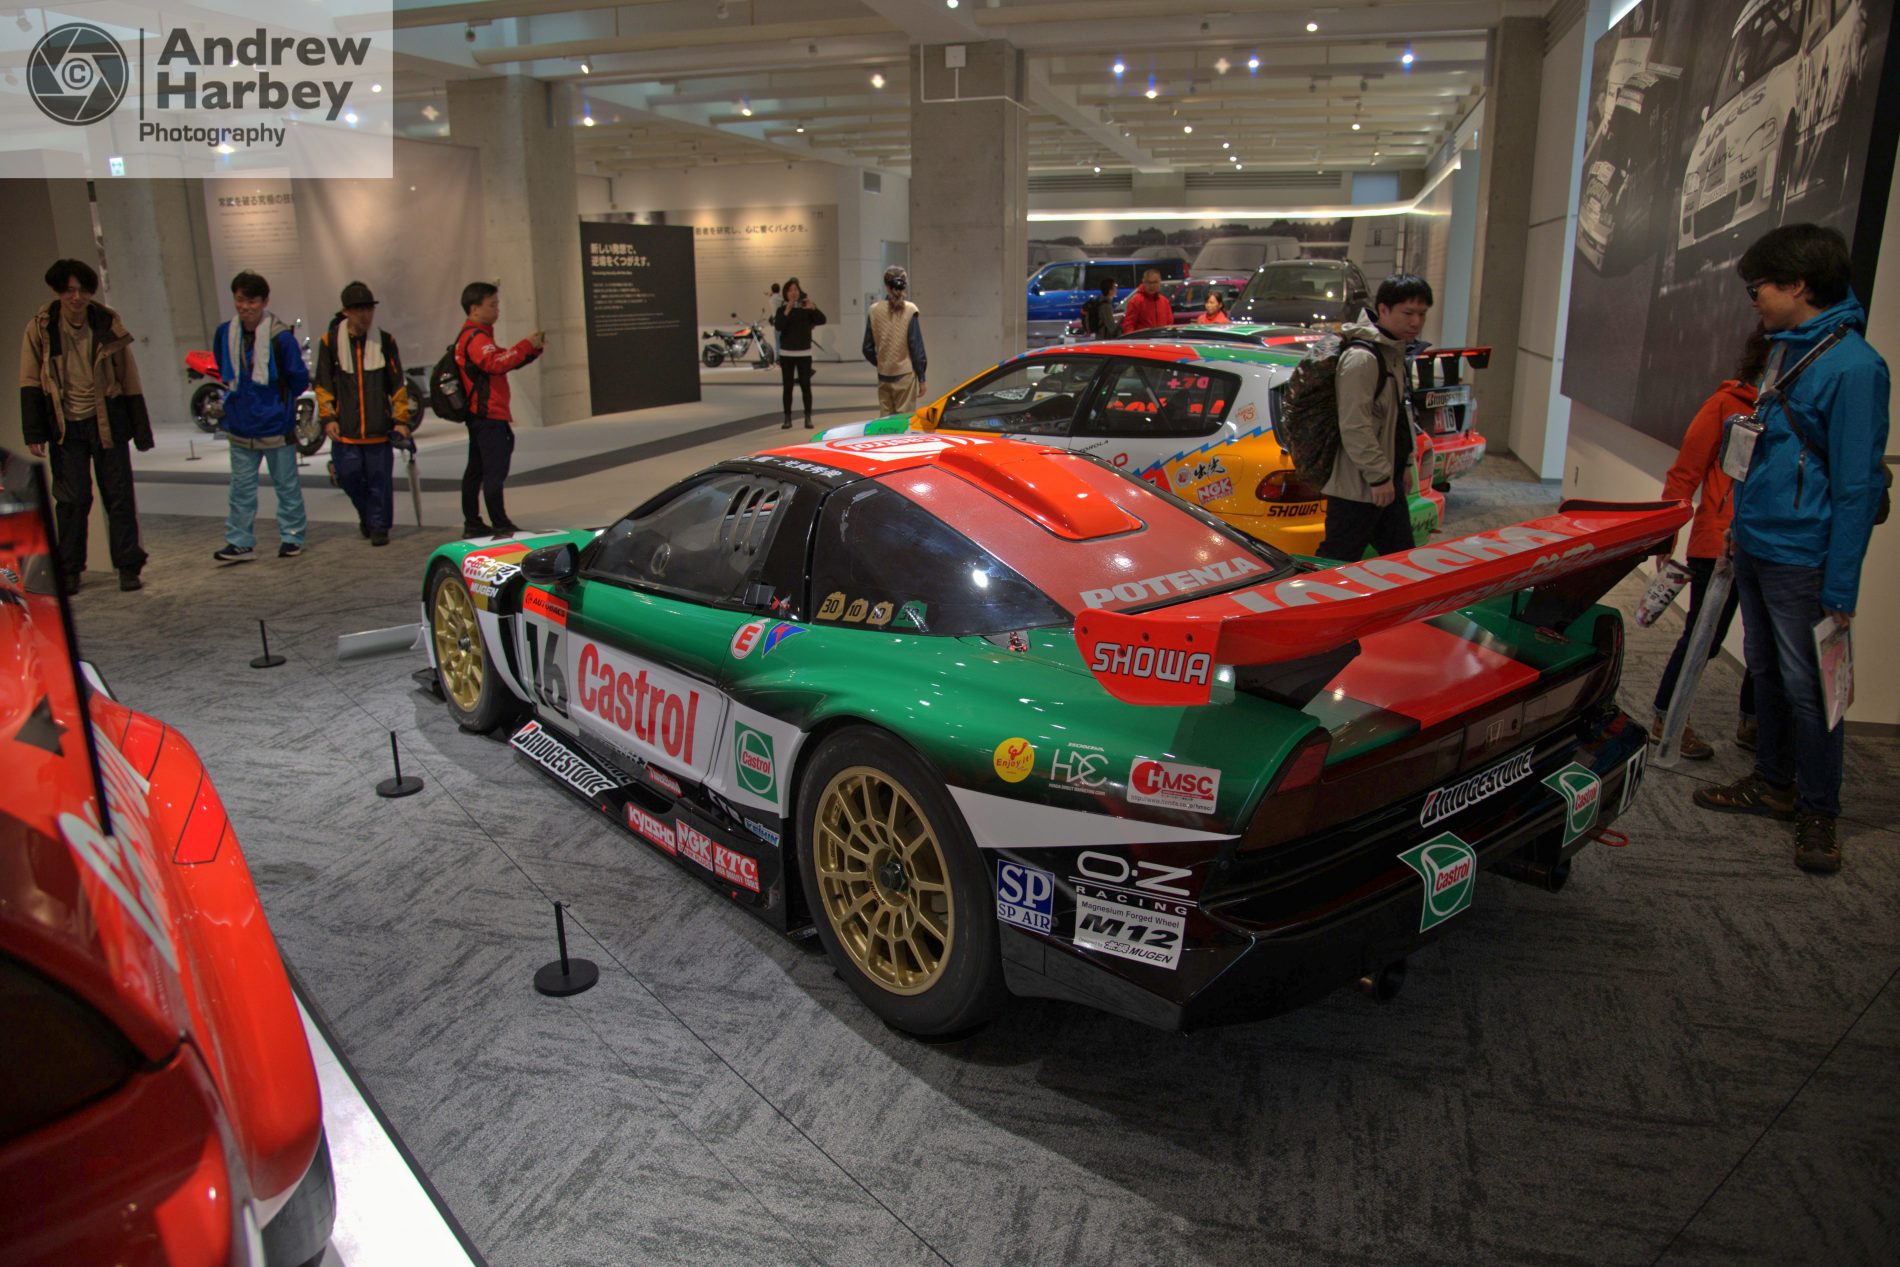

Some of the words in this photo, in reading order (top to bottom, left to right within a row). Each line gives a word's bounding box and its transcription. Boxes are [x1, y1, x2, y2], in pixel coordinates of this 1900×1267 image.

[1198, 479, 1233, 502] NGK
[1267, 503, 1319, 517] SHOWA
[469, 581, 500, 599] MUGEN
[1080, 556, 1261, 610] POTENZA
[532, 596, 566, 618] AUTOBACS
[822, 598, 840, 613] 30
[849, 603, 862, 617] 10
[1091, 641, 1212, 686] SHOWA
[577, 642, 700, 766] Castrol
[512, 725, 613, 796] BRIDGESTONE
[741, 750, 771, 775] Castrol
[996, 758, 1022, 769] Enjoy
[1422, 750, 1535, 826] BRIDGESTONE
[1575, 782, 1598, 811] Castrol
[676, 822, 711, 861] NGK
[715, 847, 755, 880] KTC
[1435, 858, 1471, 892] Castrol
[999, 864, 1051, 909] SP
[1076, 885, 1188, 916] RACING
[998, 903, 1016, 919] SP
[1022, 911, 1050, 931] AIR
[1081, 900, 1124, 918] Magnesium
[1125, 910, 1153, 924] Forged
[1154, 916, 1180, 929] Wheel
[1079, 913, 1179, 950] M12
[1129, 946, 1173, 964] MUGEN
